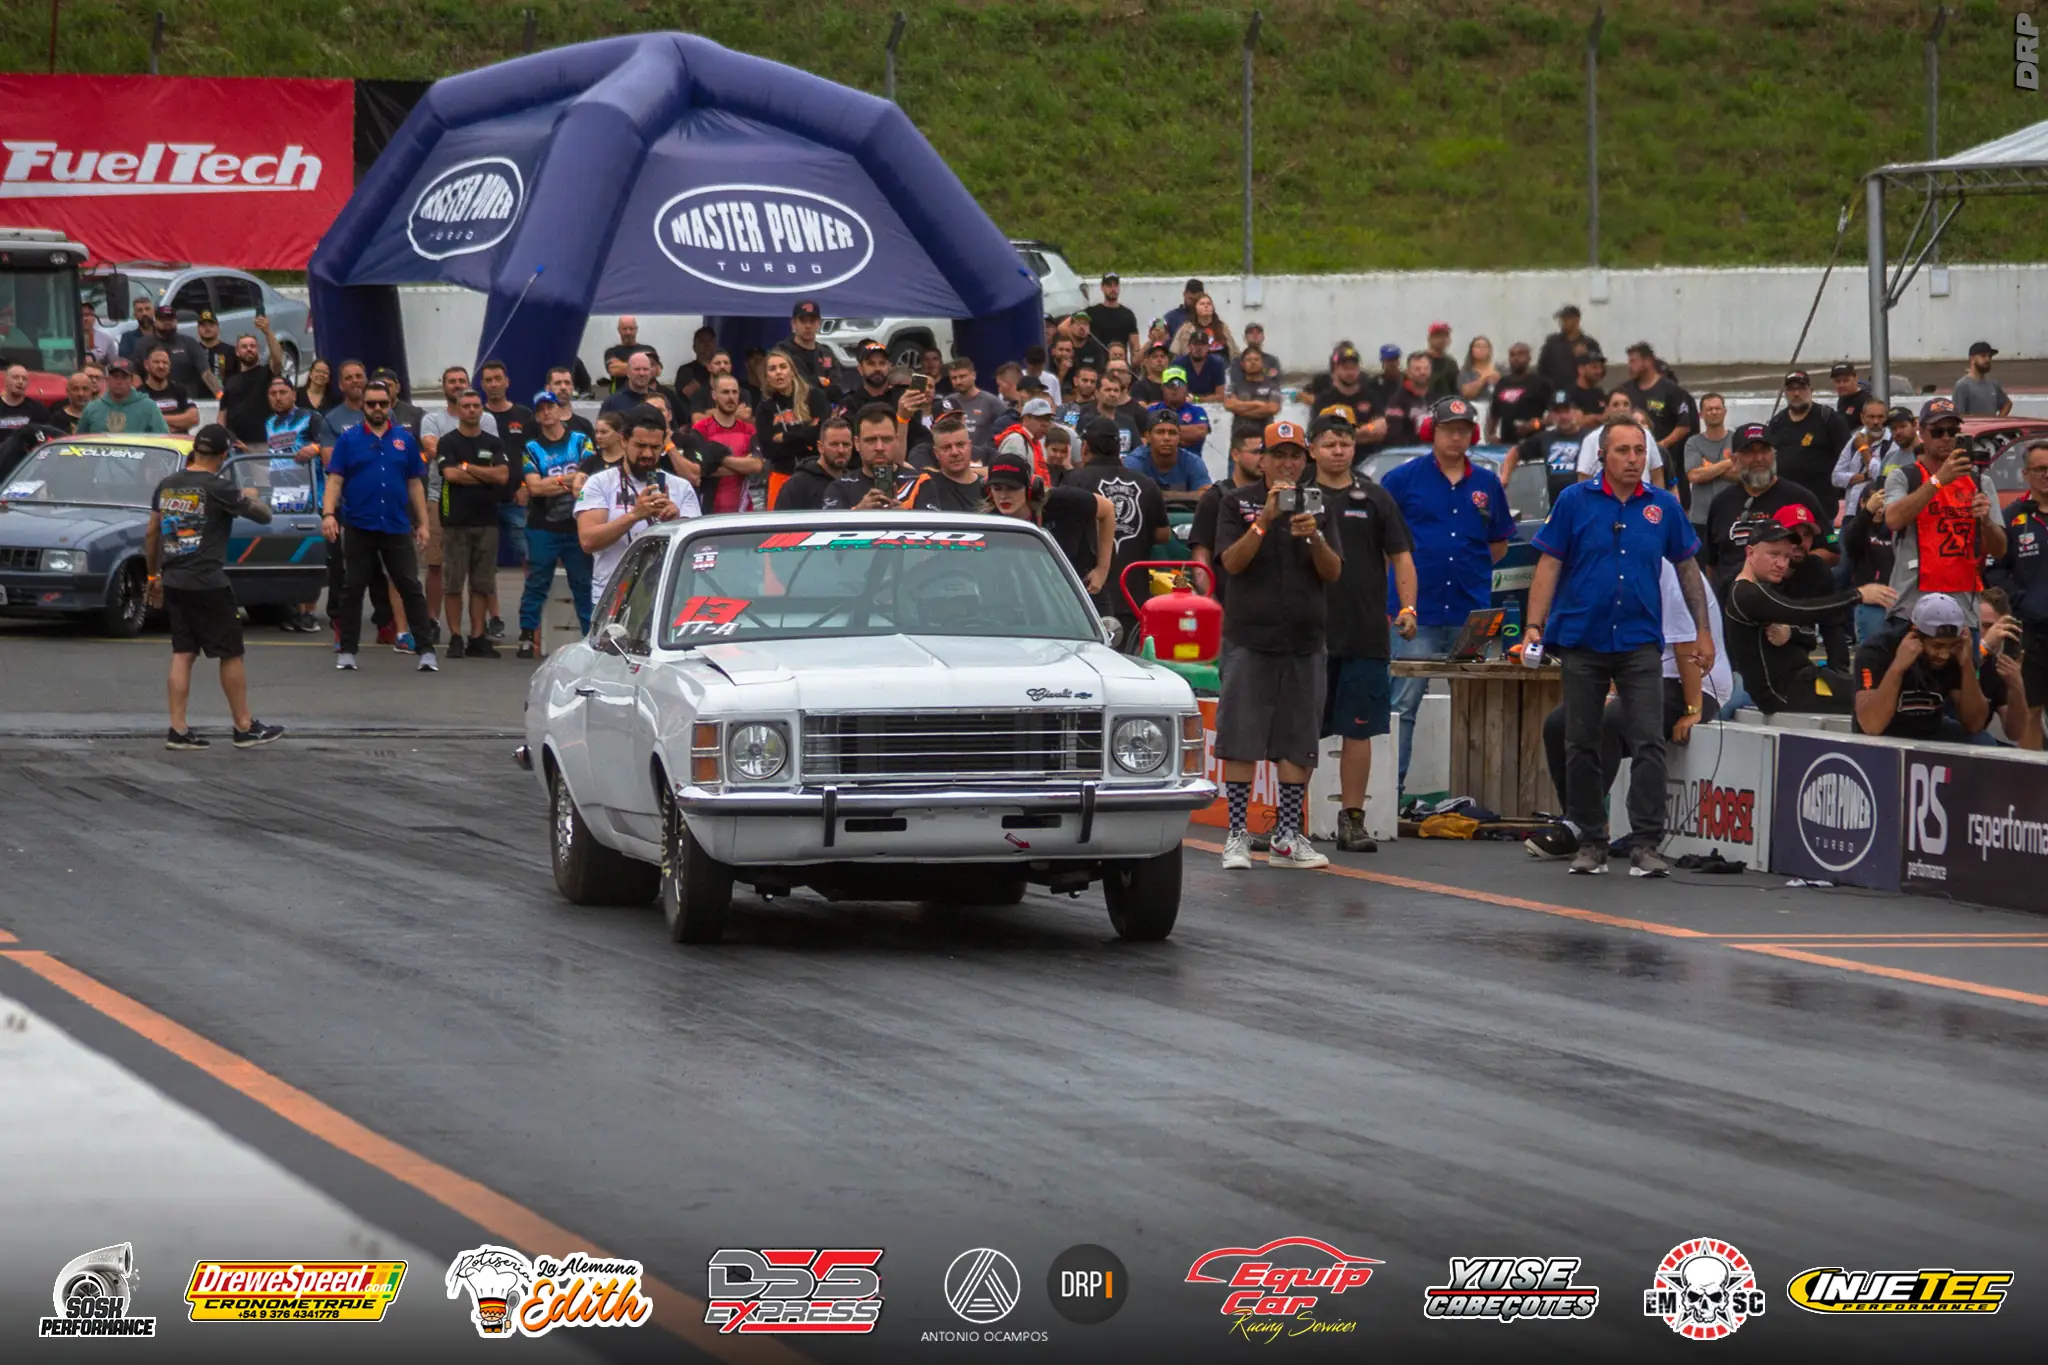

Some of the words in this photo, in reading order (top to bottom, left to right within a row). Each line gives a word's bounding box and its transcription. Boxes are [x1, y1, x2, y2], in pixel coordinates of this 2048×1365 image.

[2, 141, 323, 191] FuelTech
[671, 201, 766, 254] MASTER
[766, 201, 855, 254] POWER
[717, 260, 823, 275] TURBO
[798, 530, 985, 547] PRO
[672, 595, 753, 629] 13
[676, 620, 742, 637] TT-A
[1802, 772, 1837, 828] MASTER
[1837, 773, 1872, 830] POWER
[1908, 763, 1952, 856] RS
[1815, 836, 1854, 853] TURBO
[1907, 859, 1948, 881] performance
